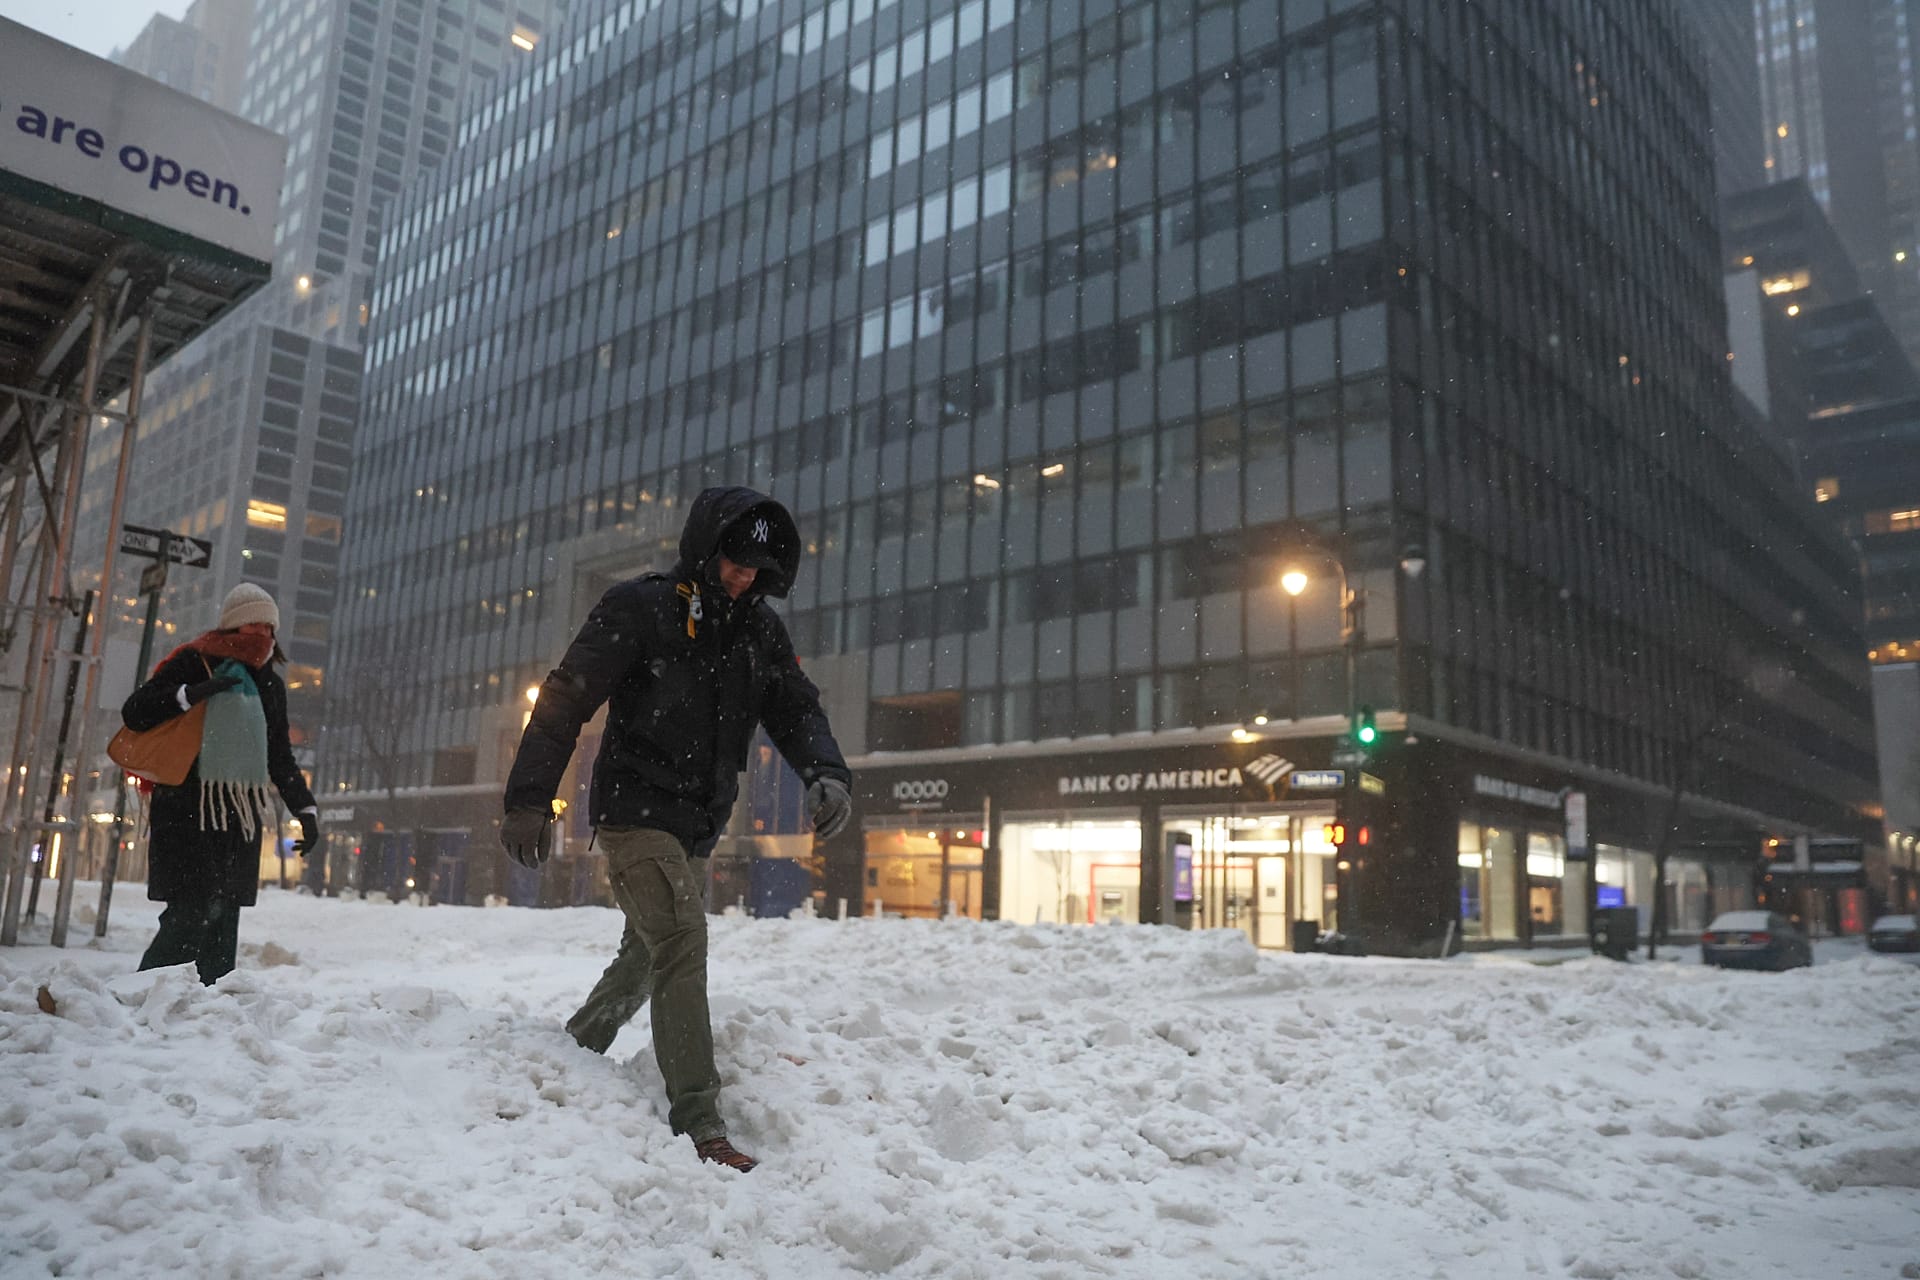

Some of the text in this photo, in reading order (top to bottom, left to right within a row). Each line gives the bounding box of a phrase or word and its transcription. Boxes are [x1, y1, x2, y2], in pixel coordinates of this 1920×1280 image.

[16, 105, 251, 215] are open.
[753, 518, 769, 543] NY
[124, 532, 197, 558] ONE WAY
[1059, 767, 1243, 794] BANK OF AMERICA
